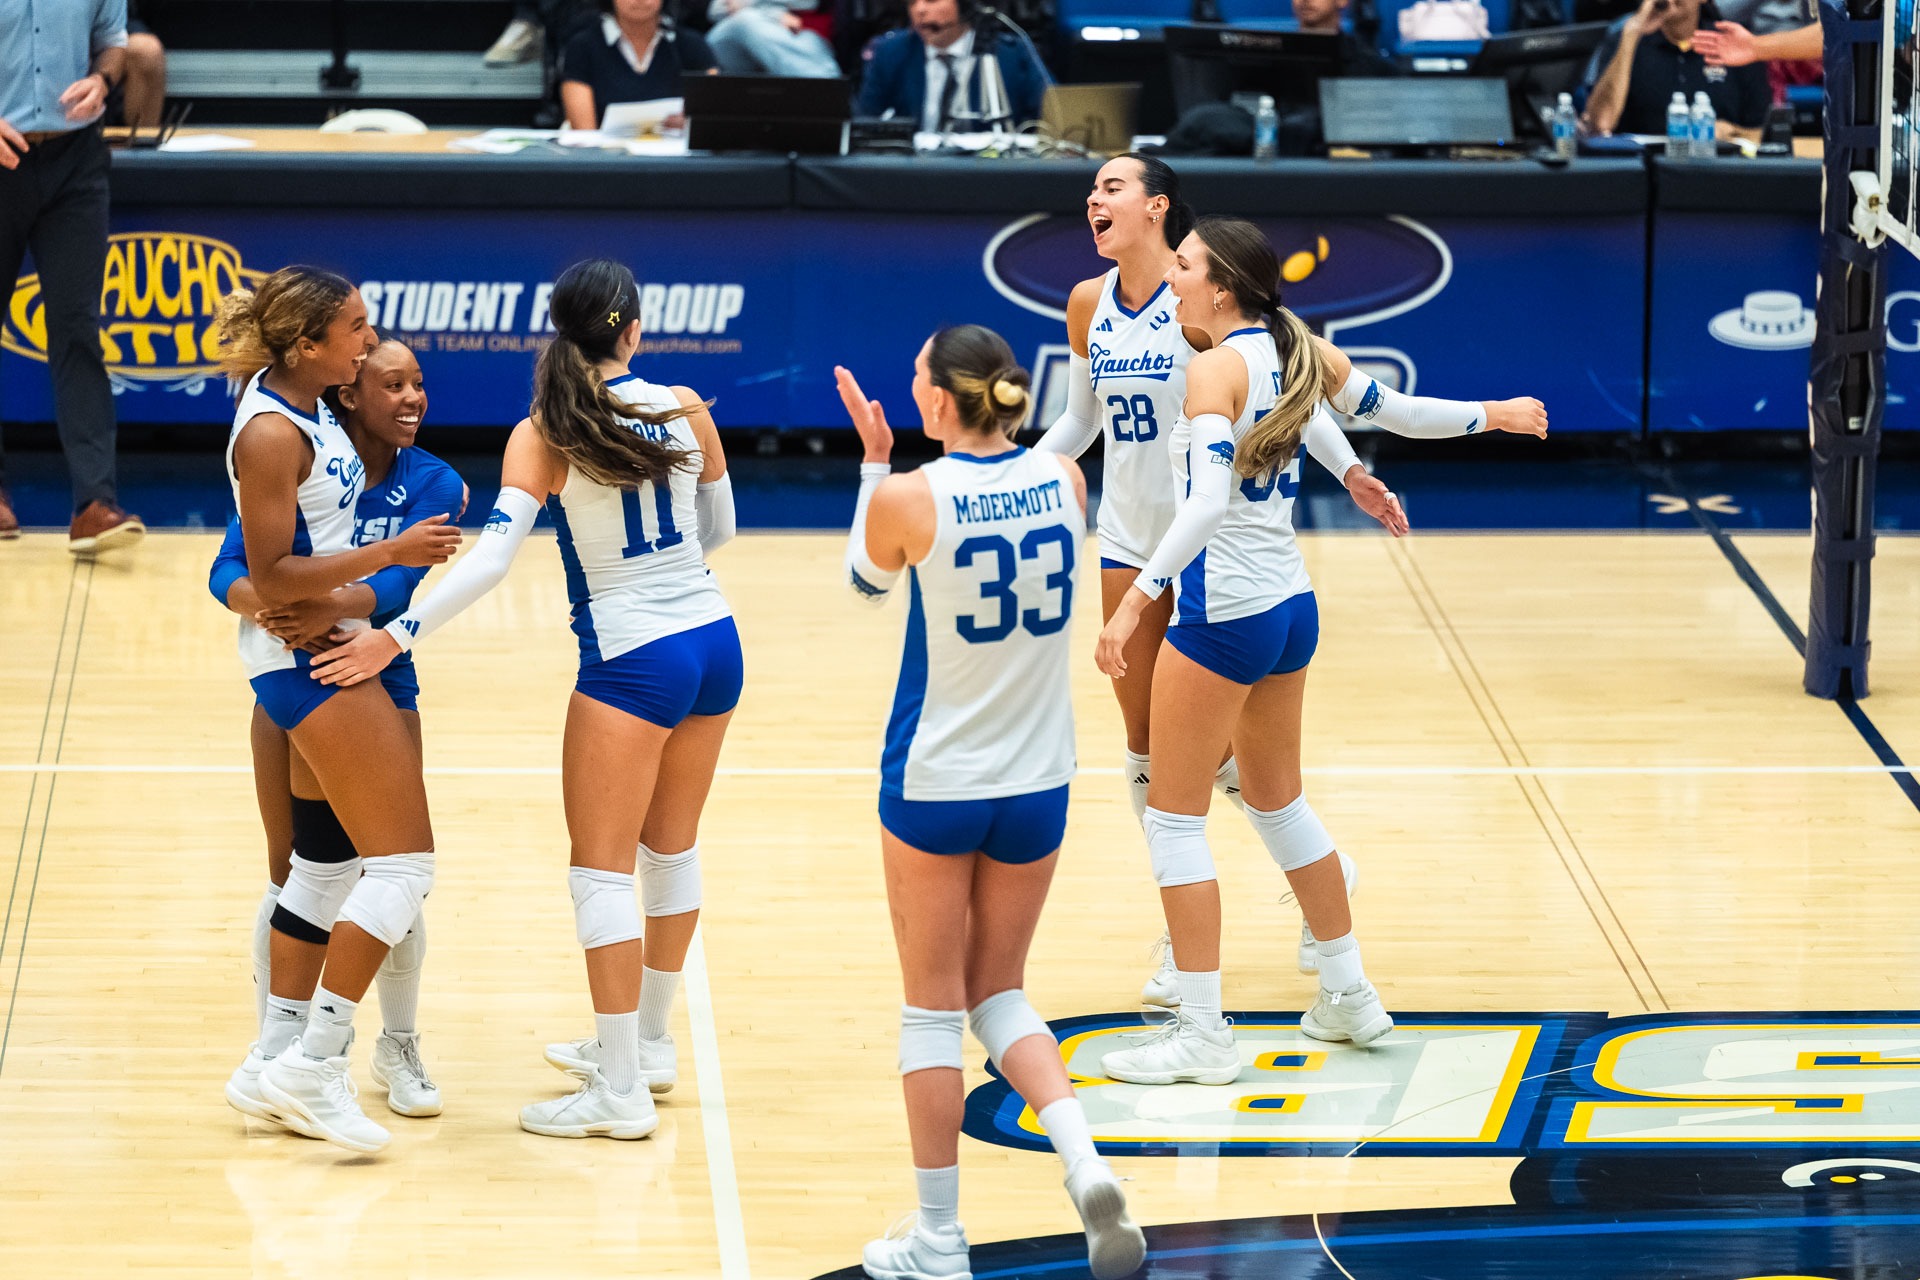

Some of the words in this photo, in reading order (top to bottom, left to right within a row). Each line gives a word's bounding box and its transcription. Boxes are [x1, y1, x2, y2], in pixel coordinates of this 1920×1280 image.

[100, 236, 242, 318] AUCHO
[359, 281, 524, 332] STUDENT
[638, 283, 745, 333] ROUP
[1090, 342, 1174, 393] Gauchos
[1107, 394, 1158, 442] 28
[620, 478, 683, 559] 11
[953, 480, 1062, 524] McDERMOTT
[955, 523, 1075, 644] 33
